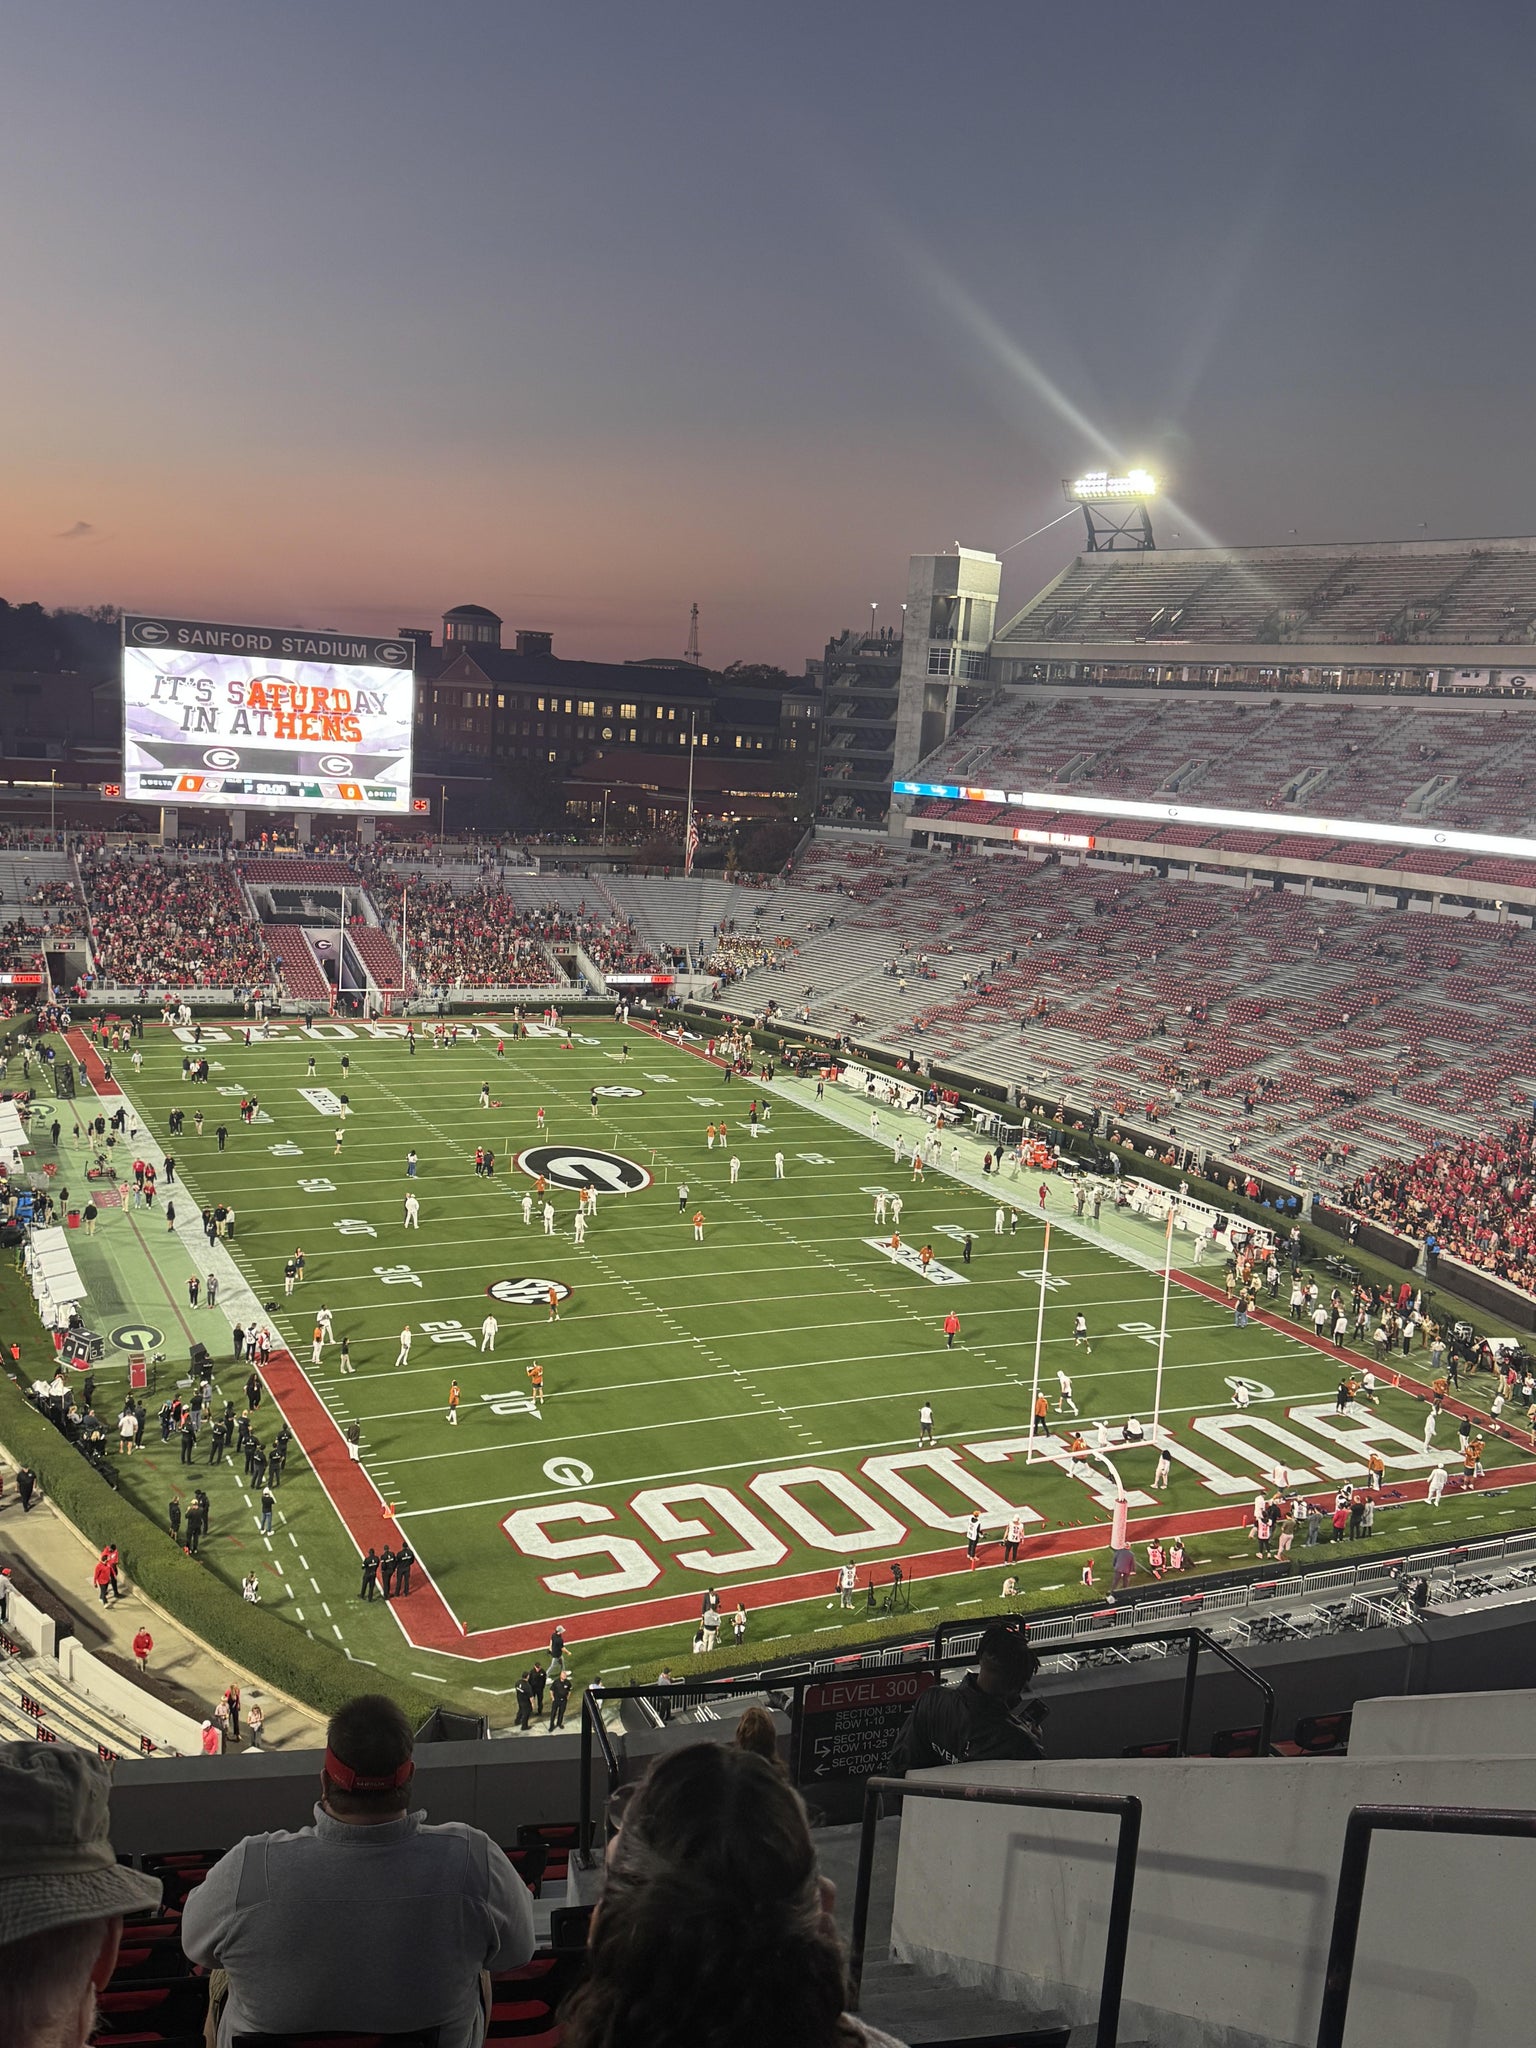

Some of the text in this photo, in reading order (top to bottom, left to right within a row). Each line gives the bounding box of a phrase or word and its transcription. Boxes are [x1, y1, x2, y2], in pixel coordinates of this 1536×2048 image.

[177, 628, 367, 658] SANFORD STADIUM
[150, 675, 388, 716] IT'S SATURDAY
[180, 705, 363, 743] IN ATHENS
[105, 784, 120, 796] 25
[414, 800, 427, 811] 25
[173, 1022, 583, 1044] GEORGIA
[297, 1178, 337, 1193] 50
[333, 1218, 374, 1235] 40
[373, 1264, 420, 1285] 30
[420, 1319, 472, 1344] 20
[480, 1390, 537, 1416] 10
[500, 1401, 1467, 1598] BULLDOGS
[821, 1678, 917, 1706] LEVEL 300
[836, 1704, 902, 1721] SECTION 321
[834, 1716, 885, 1731] ROW 1-10
[833, 1728, 900, 1745] SECTION 321
[832, 1739, 888, 1755] ROW 11-25
[832, 1750, 893, 1768] SECTION 32
[848, 1763, 875, 1775] ROW
